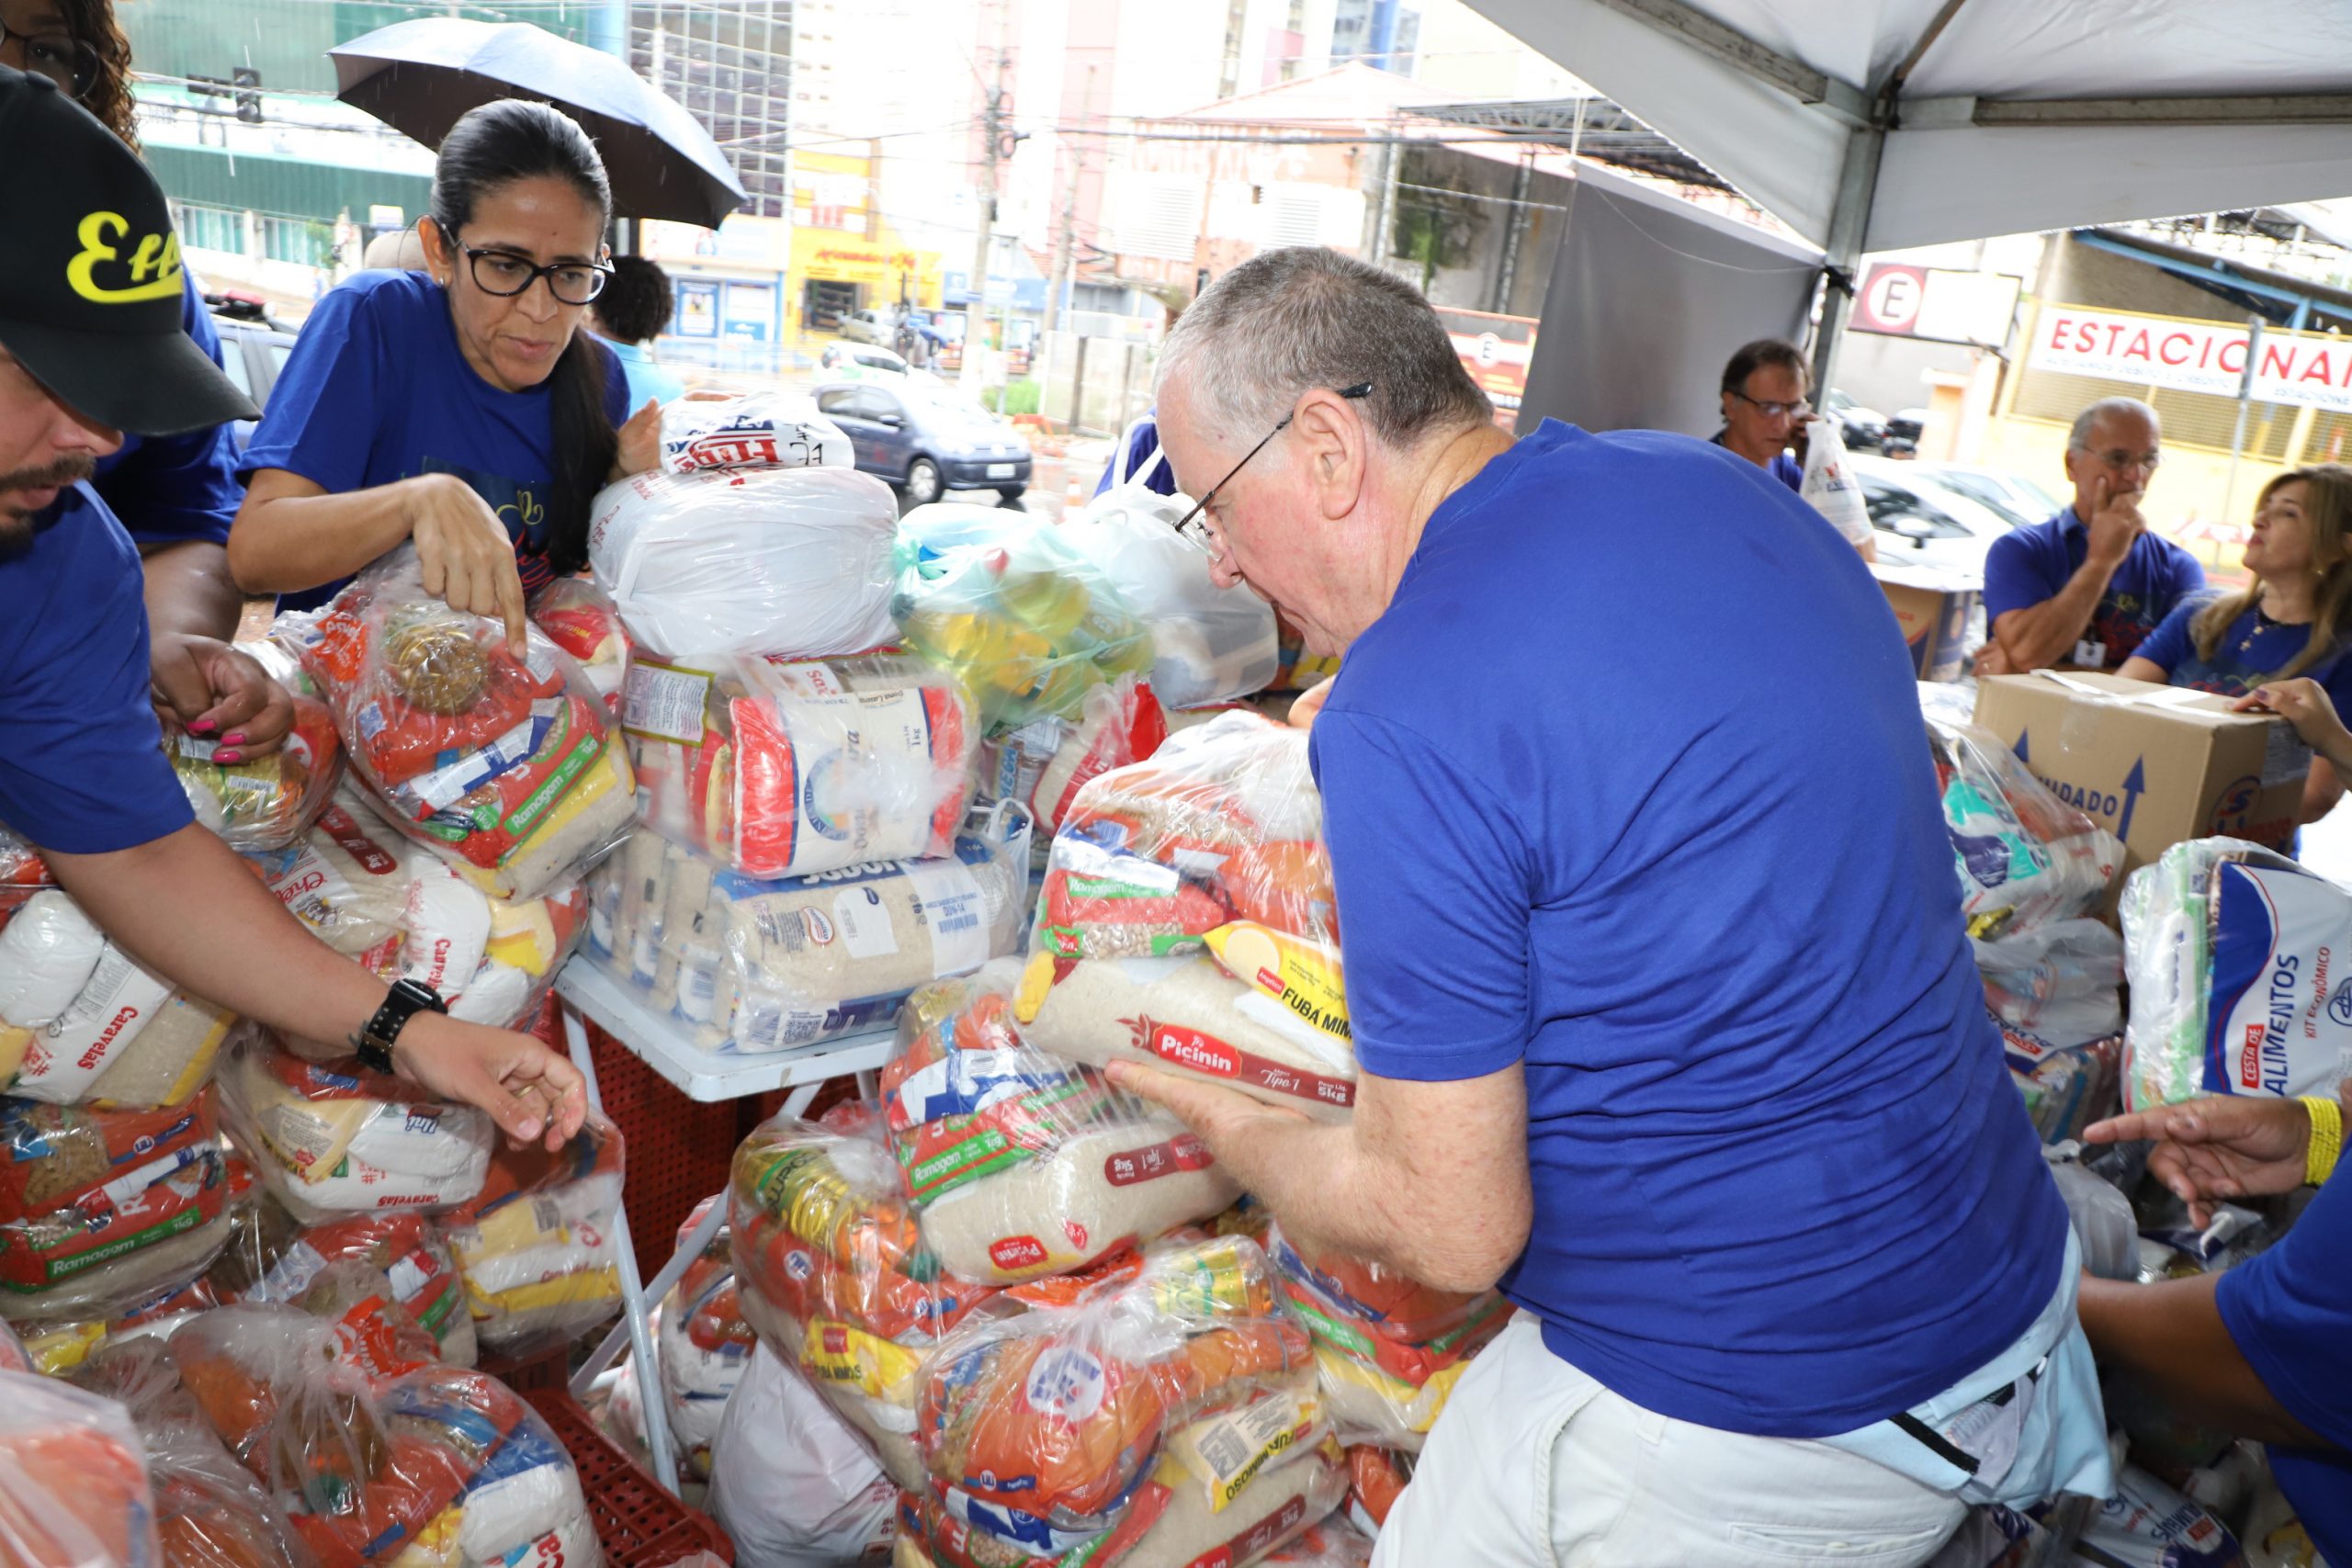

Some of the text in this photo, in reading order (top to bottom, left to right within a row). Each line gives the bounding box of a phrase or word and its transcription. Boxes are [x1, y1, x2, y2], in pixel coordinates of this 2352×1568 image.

[1882, 279, 1908, 318] E
[1482, 341, 1493, 359] E
[1282, 987, 1325, 1025] FUBÁ
[76, 1005, 139, 1070] Caravelas
[2264, 953, 2299, 1098] ALIMENTOS
[2304, 1020, 2318, 1039] KIT
[1160, 1033, 1233, 1073] Picinin
[2242, 1027, 2262, 1082] CESTA DE
[1261, 1068, 1301, 1091] Tipo 1
[1317, 1086, 1347, 1103] 5kg
[1113, 1157, 1134, 1173] 5kg
[377, 1193, 440, 1207] Caravelas
[173, 1216, 195, 1233] 1kg
[1226, 1450, 1269, 1501] MIMOSO
